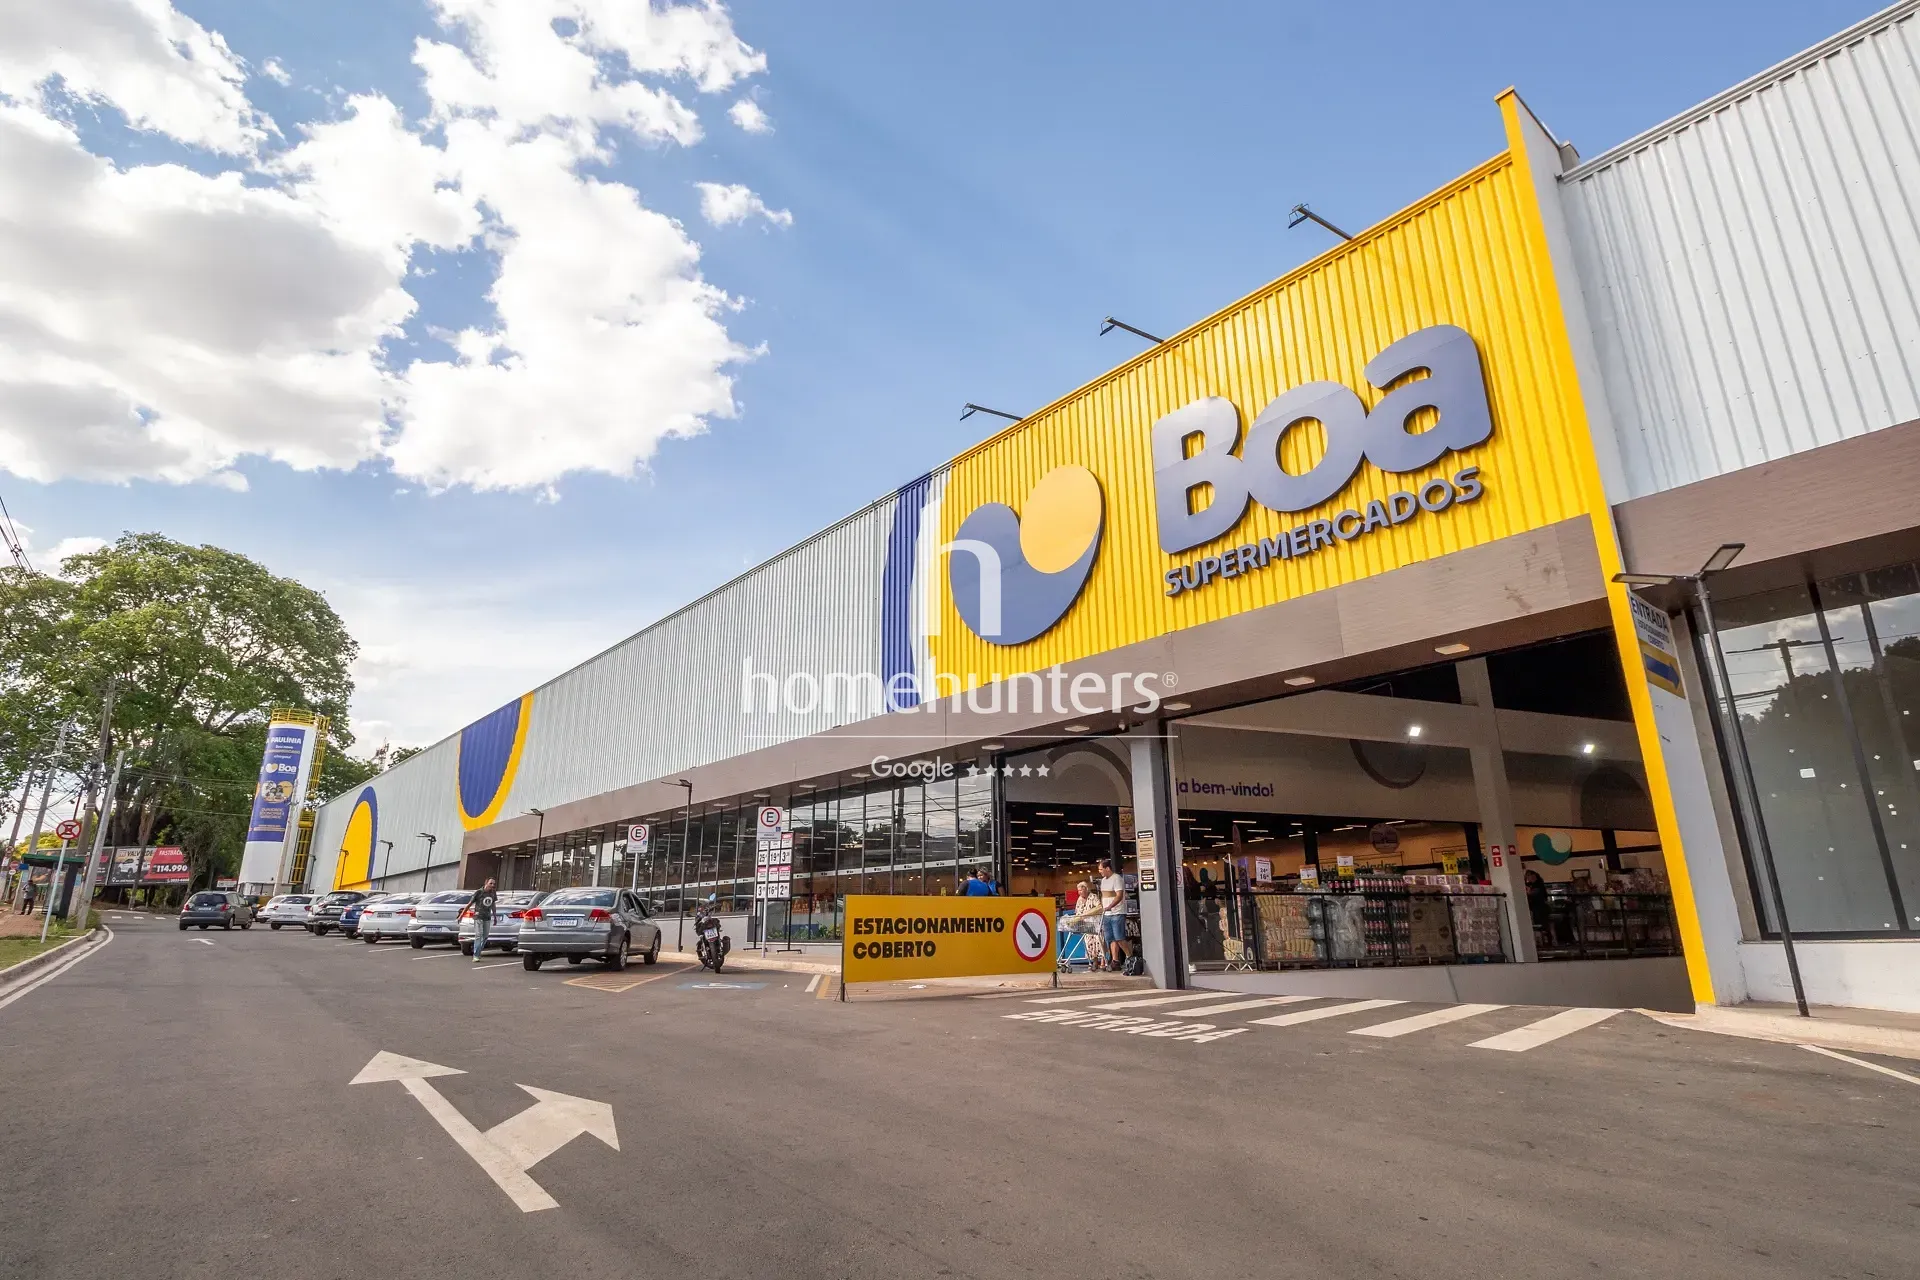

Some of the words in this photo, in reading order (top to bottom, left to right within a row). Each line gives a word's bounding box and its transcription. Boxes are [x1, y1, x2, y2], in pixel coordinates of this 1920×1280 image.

[1151, 324, 1494, 554] Boa
[1164, 466, 1485, 597] SUPERMERCADOS
[1630, 596, 1669, 633] ENTRADA
[278, 763, 298, 773] Boa
[1175, 778, 1189, 796] ja
[1192, 778, 1274, 797] bem-vindo!
[766, 812, 774, 823] E
[635, 828, 642, 838] E
[853, 917, 1005, 935] ESTACIONAMENTO
[853, 940, 936, 959] COBERTO
[1000, 1009, 1250, 1043] ENTRADA
